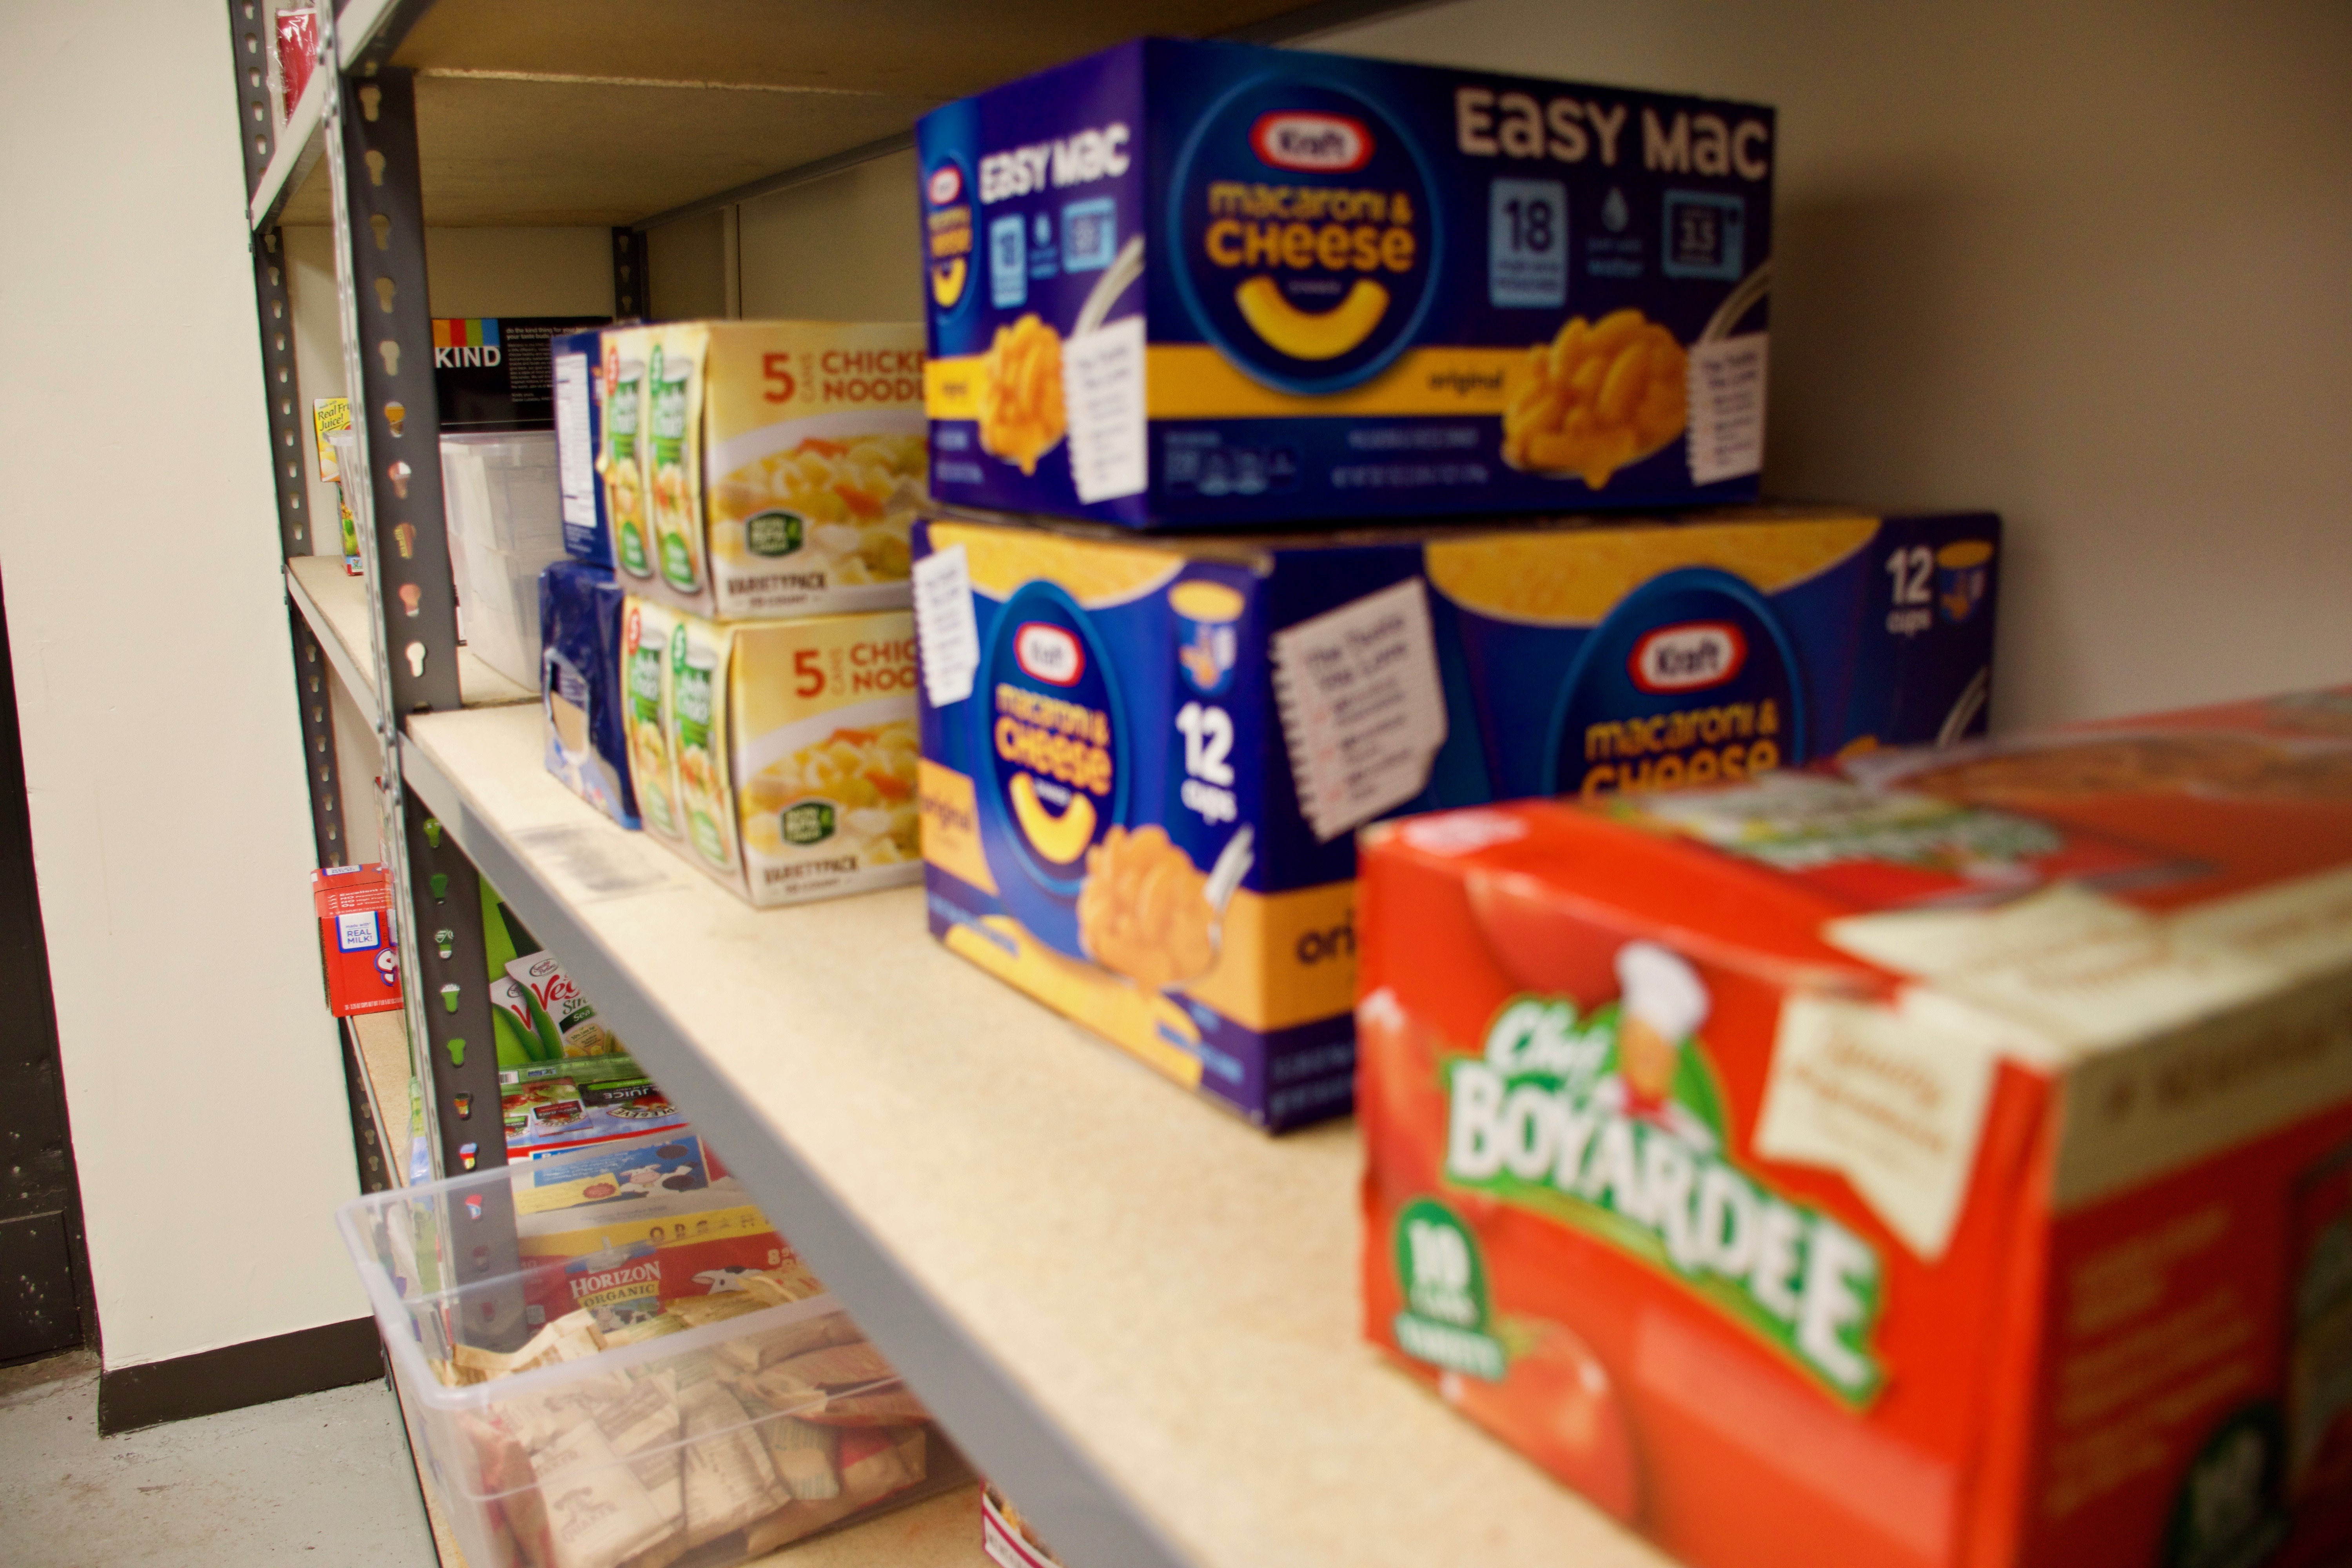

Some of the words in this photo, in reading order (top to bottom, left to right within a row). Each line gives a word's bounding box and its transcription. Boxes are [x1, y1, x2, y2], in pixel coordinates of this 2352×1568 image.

[1502, 198, 1554, 253] 18
[436, 346, 501, 368] KIND
[763, 351, 796, 404] 5
[318, 405, 337, 421] Real
[319, 413, 344, 431] Juice!
[1886, 545, 1935, 606] 12
[793, 648, 827, 699] 5
[1175, 701, 1235, 787] 12
[347, 929, 372, 937] REAL
[347, 935, 372, 945] MILK!
[573, 1008, 591, 1022] Sea
[603, 1087, 650, 1100] JUICE
[1448, 1058, 1880, 1391] BOYARDEE
[569, 1260, 662, 1299] HORIZON
[583, 1283, 656, 1309] ORGANIC
